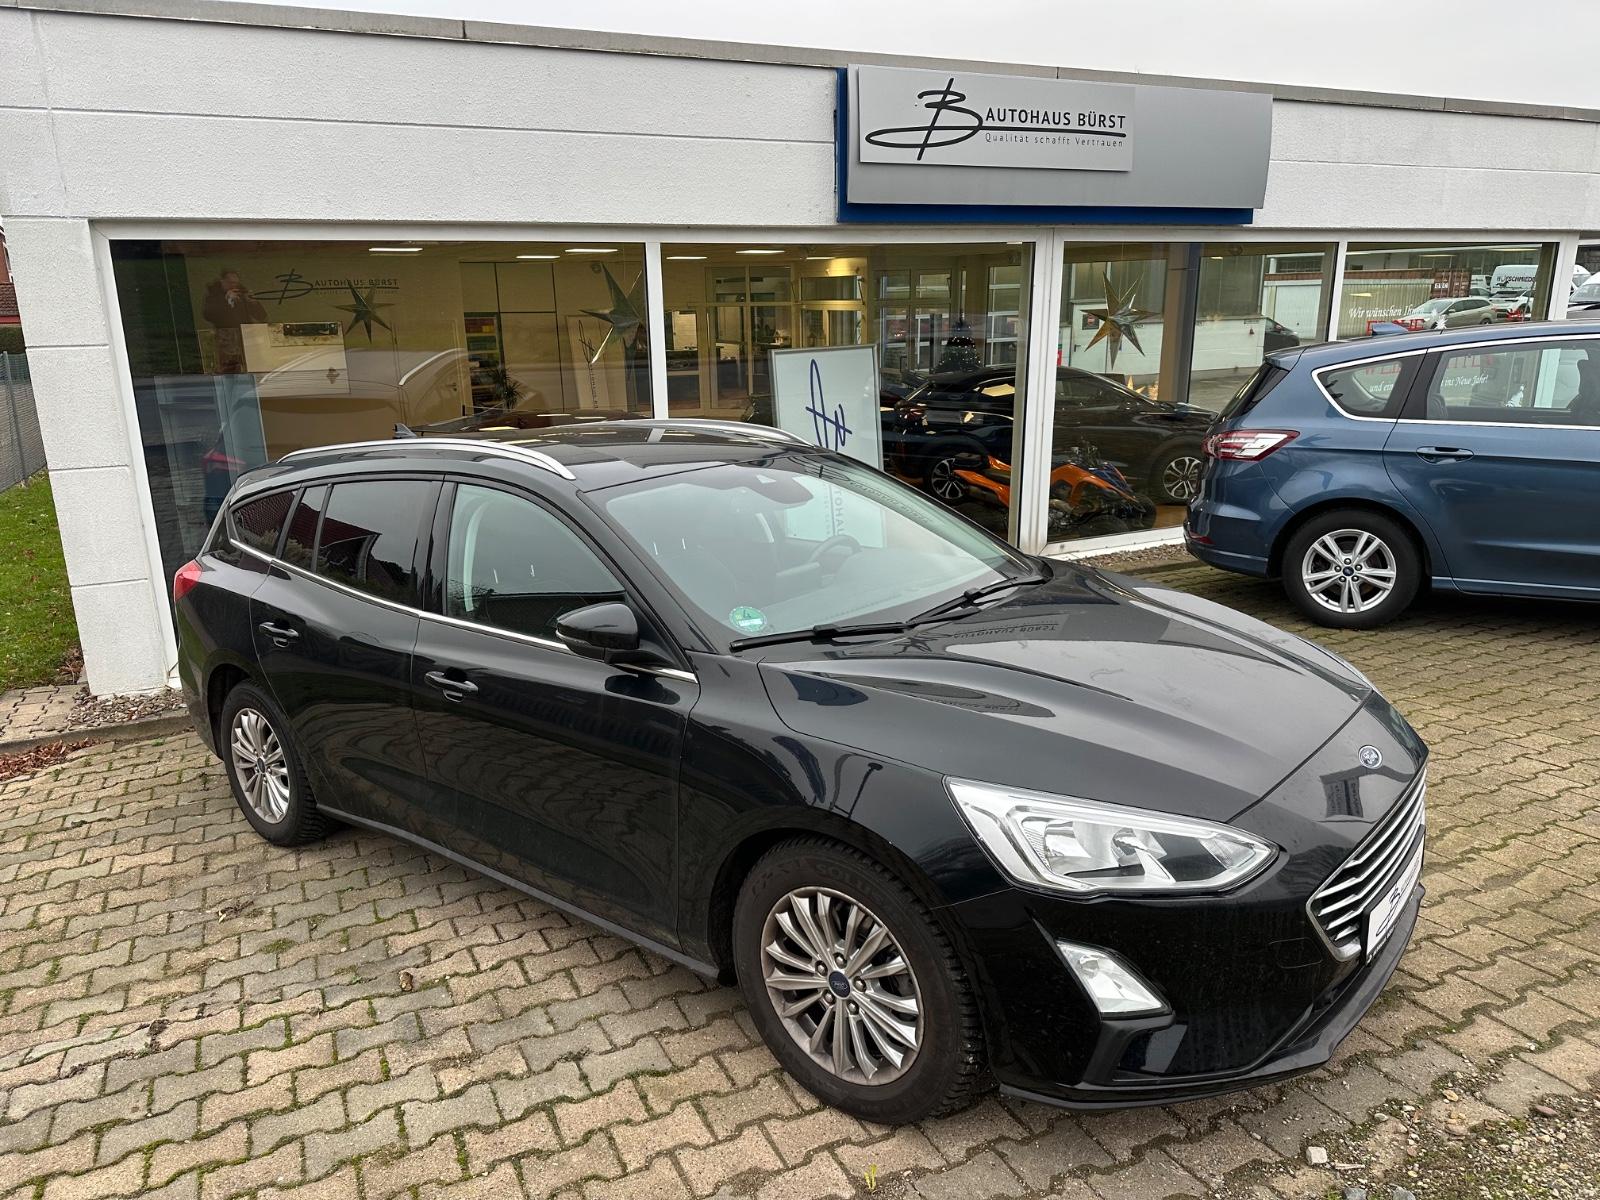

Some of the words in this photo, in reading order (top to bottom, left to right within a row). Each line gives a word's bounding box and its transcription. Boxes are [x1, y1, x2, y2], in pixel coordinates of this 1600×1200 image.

[985, 107, 1071, 126] AUTOHAUS
[1077, 110, 1126, 129] BÜRST
[985, 132, 1029, 143] Qualität
[1034, 135, 1070, 145] schafft
[1075, 137, 1123, 147] Vertrauen
[1349, 306, 1364, 318] Wir
[1366, 305, 1402, 317] wünschen
[1454, 376, 1471, 387] Neue
[1472, 374, 1489, 385] Jahr!
